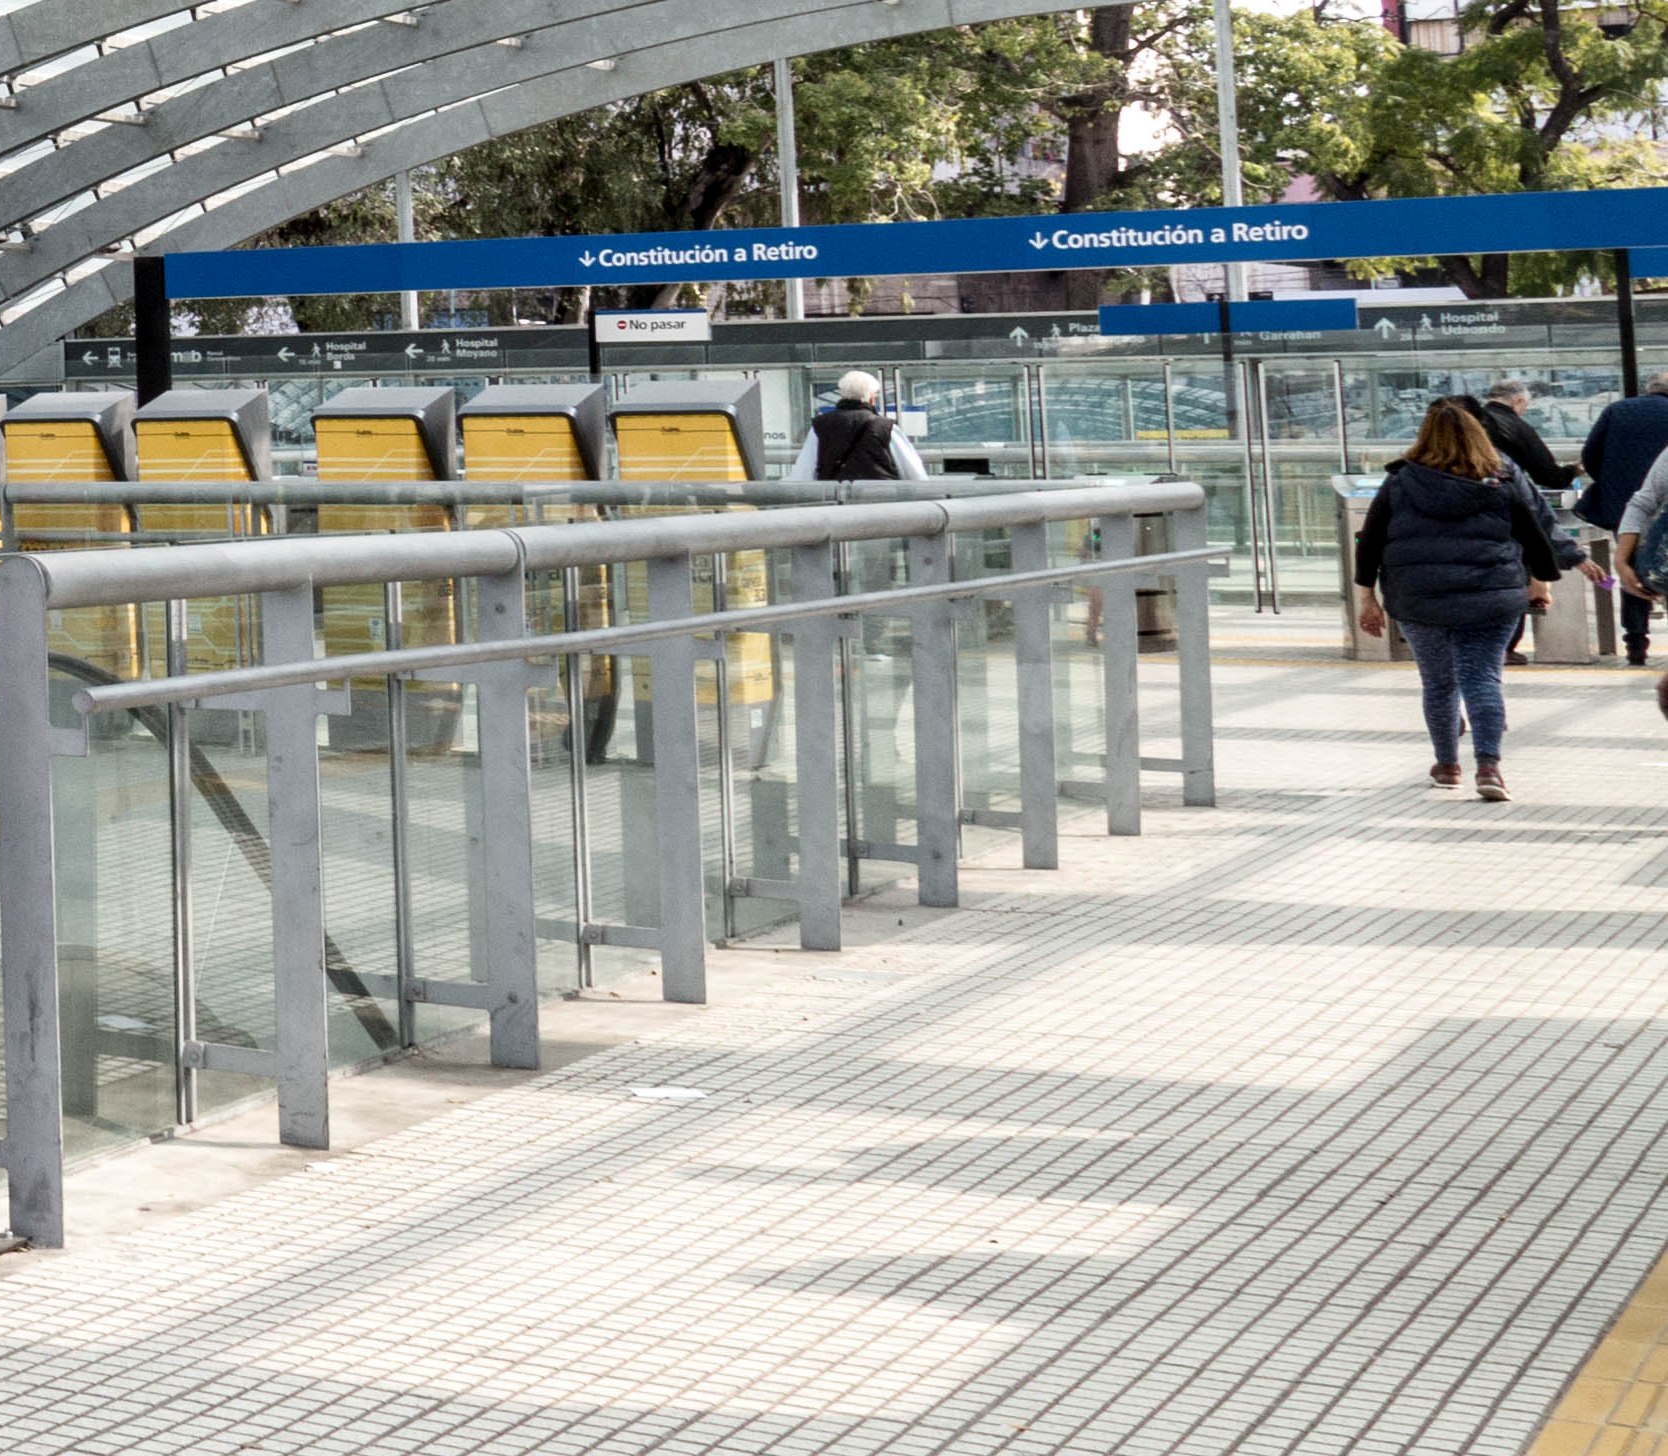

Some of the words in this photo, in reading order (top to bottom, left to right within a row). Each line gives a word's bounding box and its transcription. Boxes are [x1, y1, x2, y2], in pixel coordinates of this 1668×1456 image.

[1051, 225, 1203, 250] Constitución
[1210, 228, 1226, 244] a
[1232, 220, 1309, 242] Retiro
[598, 244, 728, 268] Constitución
[734, 249, 747, 262] a
[752, 241, 818, 261] Retiro
[1439, 311, 1499, 325] Hospital
[629, 320, 647, 331] No
[651, 319, 687, 333] pasar
[1441, 324, 1506, 336] Udaondo
[325, 342, 367, 352] Hospital
[455, 338, 498, 349] Hospital
[326, 352, 356, 362] Borda
[456, 348, 498, 360] Moyano
